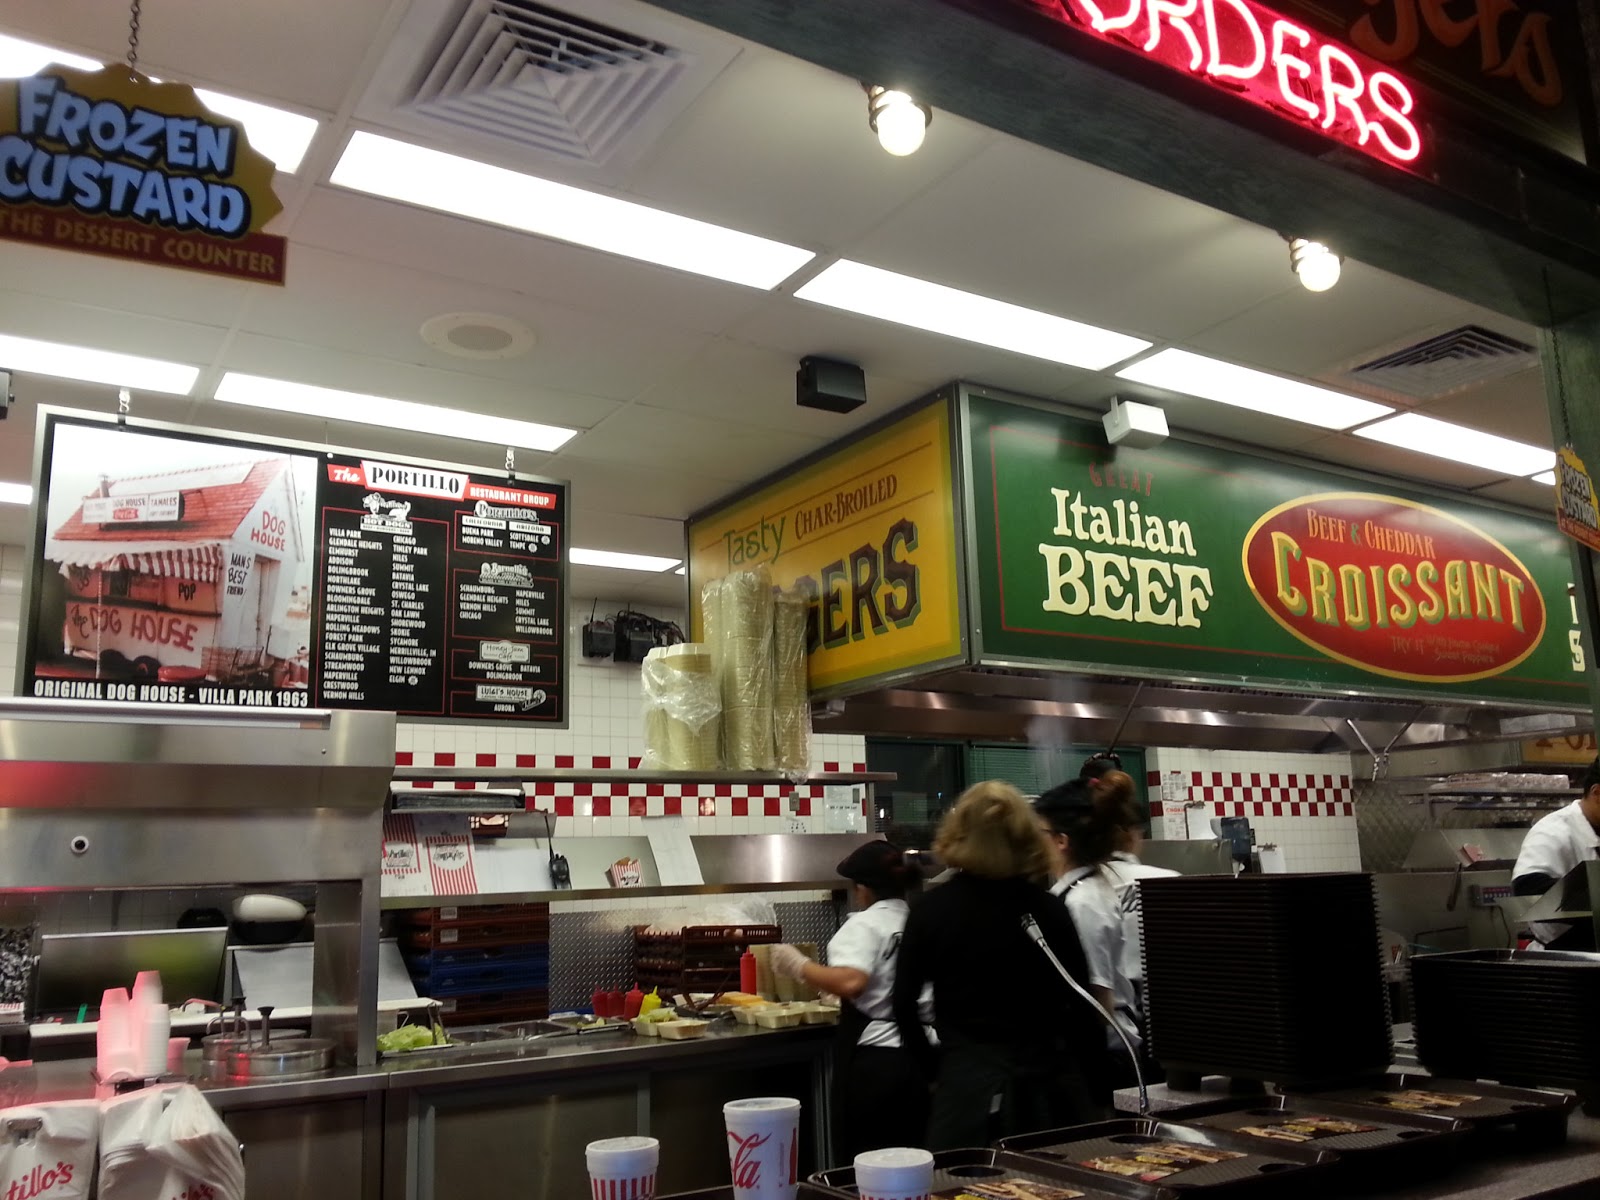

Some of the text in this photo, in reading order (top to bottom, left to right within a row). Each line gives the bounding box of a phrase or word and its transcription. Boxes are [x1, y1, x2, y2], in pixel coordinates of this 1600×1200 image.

[18, 77, 234, 174] FROZEN
[0, 135, 247, 234] CUSTARD
[54, 217, 155, 252] DESSERT
[162, 238, 275, 274] COUNTER
[334, 467, 550, 506] The PORTILLO RESTAURANT GROUP
[262, 510, 286, 536] DOG
[1050, 487, 1197, 557] Italian
[329, 528, 345, 537] VILLA
[346, 529, 361, 539] PARK
[462, 527, 494, 537] BUENA PARK
[1307, 509, 1347, 543] BEEF
[1364, 520, 1437, 560] CHEDDAR
[251, 528, 286, 552] HOUSE
[393, 535, 416, 545] CHICAGO
[462, 536, 503, 548] MORENO VALLEY
[510, 532, 539, 543] SCOTTSDALE
[723, 514, 786, 567] Tasty
[329, 537, 382, 550] GLENDALE HEIGHTS
[510, 541, 525, 550] TEMPE
[329, 547, 358, 557] ELMHURST
[393, 544, 428, 556] TINLEY PARK
[328, 556, 353, 566] ADDISON
[392, 553, 408, 563] NILES
[328, 565, 369, 577] BOLINGBROOK
[392, 563, 414, 572] SUMMIT
[228, 567, 247, 584] BEST
[327, 575, 360, 585] NORTHLAKE
[392, 572, 414, 582] BATAVIA
[392, 581, 429, 592] CRYSTAL LAKE
[1038, 543, 1214, 629] BEEF
[1271, 531, 1525, 633] CROISSANT
[179, 582, 196, 600] POP
[327, 585, 376, 596] DOWNERS GROVE
[460, 584, 495, 594] SCHAUMBURG
[326, 594, 371, 605] BLOOMINGDALE
[391, 590, 415, 600] OSWEGO
[460, 593, 508, 604] GLENDALE HEIGHTS
[516, 590, 545, 600] NAPERVILLE
[391, 600, 424, 610] ST. CHARLES
[460, 602, 497, 612] VERNON HILLS
[515, 599, 530, 607] NILES
[326, 603, 385, 616] ARLINGTON HEIGHTS
[391, 609, 420, 619] OAK LAWN
[515, 607, 535, 616] SUMMIT
[326, 613, 360, 623] NAPERVILLE
[460, 611, 481, 620] CHICAGO
[390, 618, 426, 629] SHOREWOOD
[515, 616, 549, 626] CRYSTAL LAKE
[90, 607, 122, 634] DOG
[131, 613, 198, 651] HOUSE
[325, 622, 380, 635] ROLLING MEADOWS
[390, 628, 410, 637] SKOKIE
[515, 625, 553, 635] WILLOWBROOK
[325, 632, 363, 642] FOREST PARK
[390, 637, 419, 647] SYCAMORE
[325, 641, 380, 653] ELK GROVE VILLAGE
[325, 651, 364, 662] SCHAUMBURG
[390, 656, 432, 666] WILLOWBROOK
[324, 661, 364, 671] STREAMWOOD
[389, 665, 426, 675] NEW LENNOX
[469, 661, 541, 673] DOWNERS GROVE BATAVIA
[324, 671, 358, 681] NAPERVILLE
[389, 675, 405, 683] ELGIN
[486, 672, 522, 681] BOLINGBROOK
[323, 681, 359, 690] CRESTWOOD
[34, 679, 102, 700] ORIGINAL
[107, 683, 135, 701] DOG
[140, 685, 185, 703] HOUSE
[198, 688, 235, 705] VILLA
[239, 689, 273, 706] PARK
[276, 690, 308, 708] 1963
[323, 690, 364, 700] VERNON HILLS
[494, 703, 515, 712] AURORA
[4, 1161, 74, 1200] tillo's
